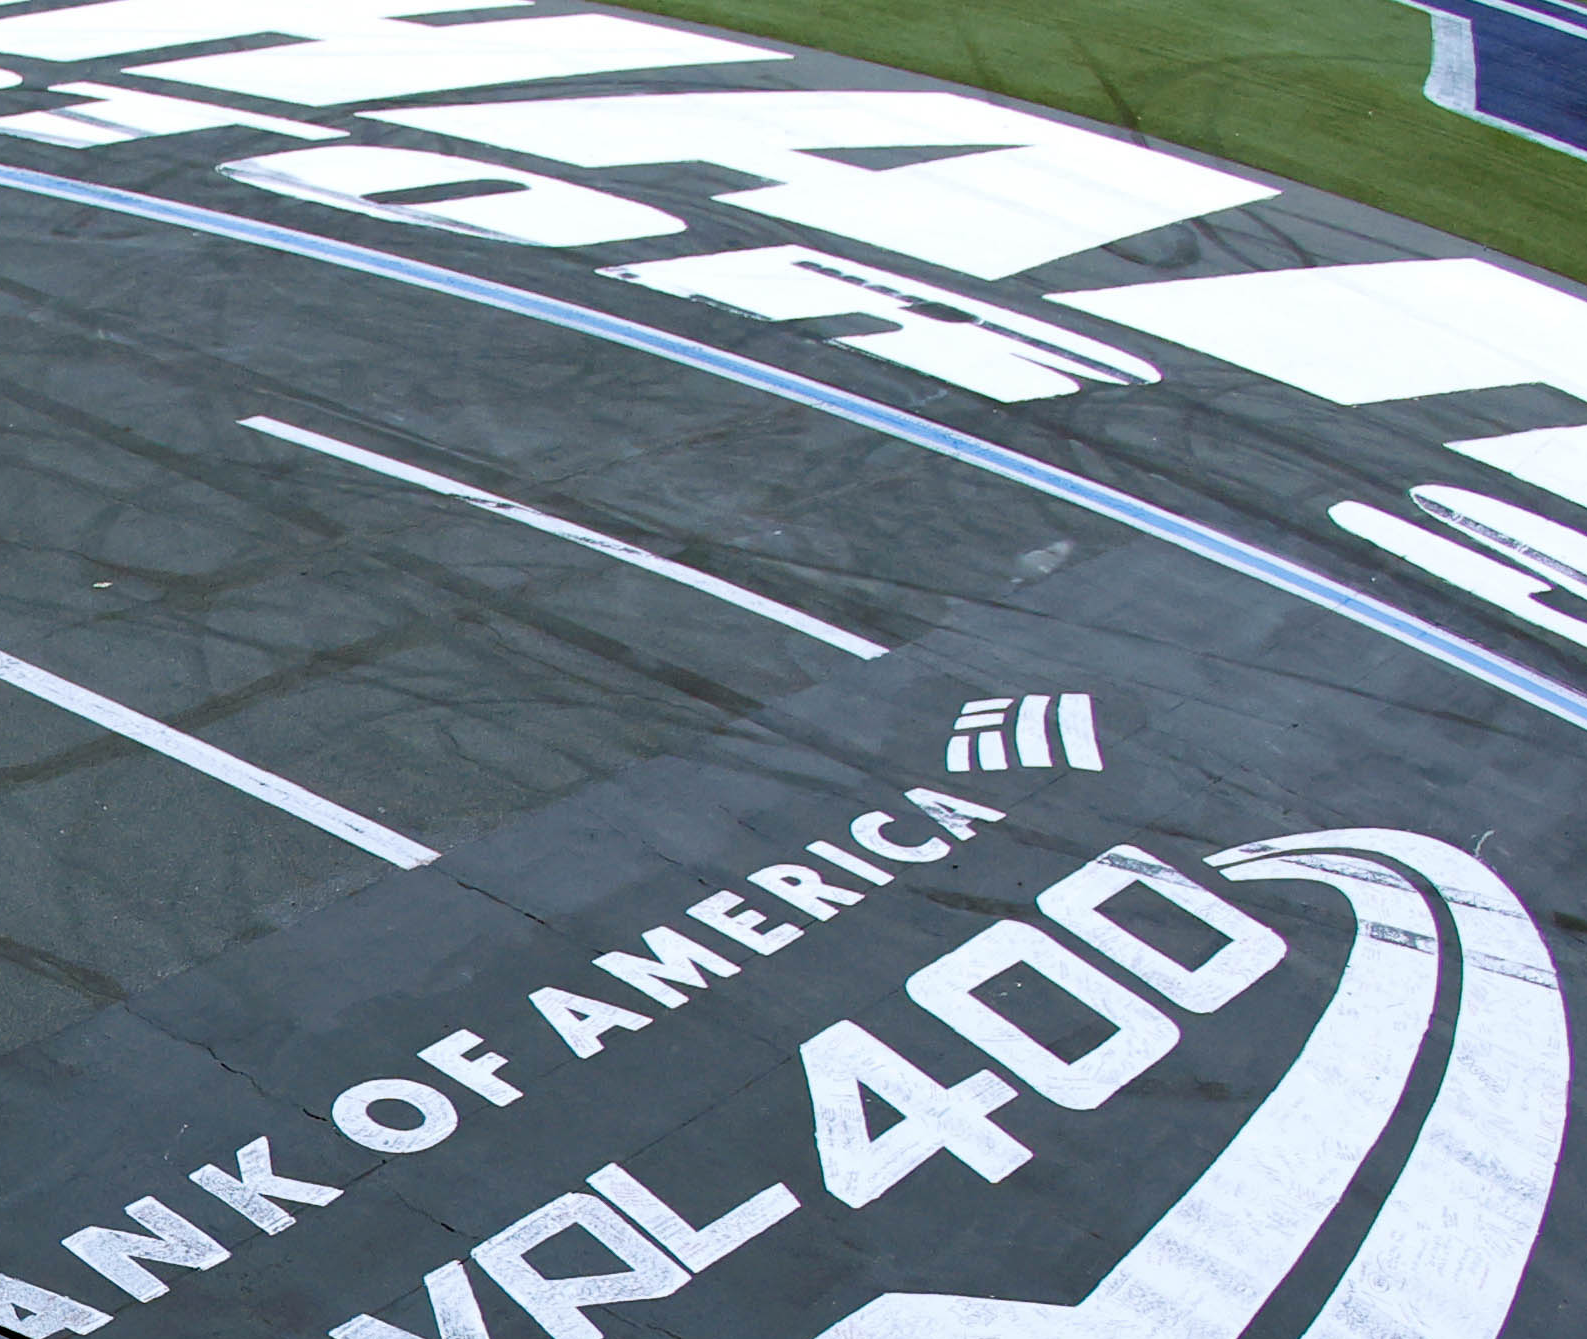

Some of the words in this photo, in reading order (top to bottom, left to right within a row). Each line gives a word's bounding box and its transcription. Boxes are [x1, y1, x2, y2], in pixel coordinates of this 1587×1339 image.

[330, 1027, 525, 1155] OF
[528, 787, 1006, 1060] AMERICA
[799, 843, 1289, 1209] 400
